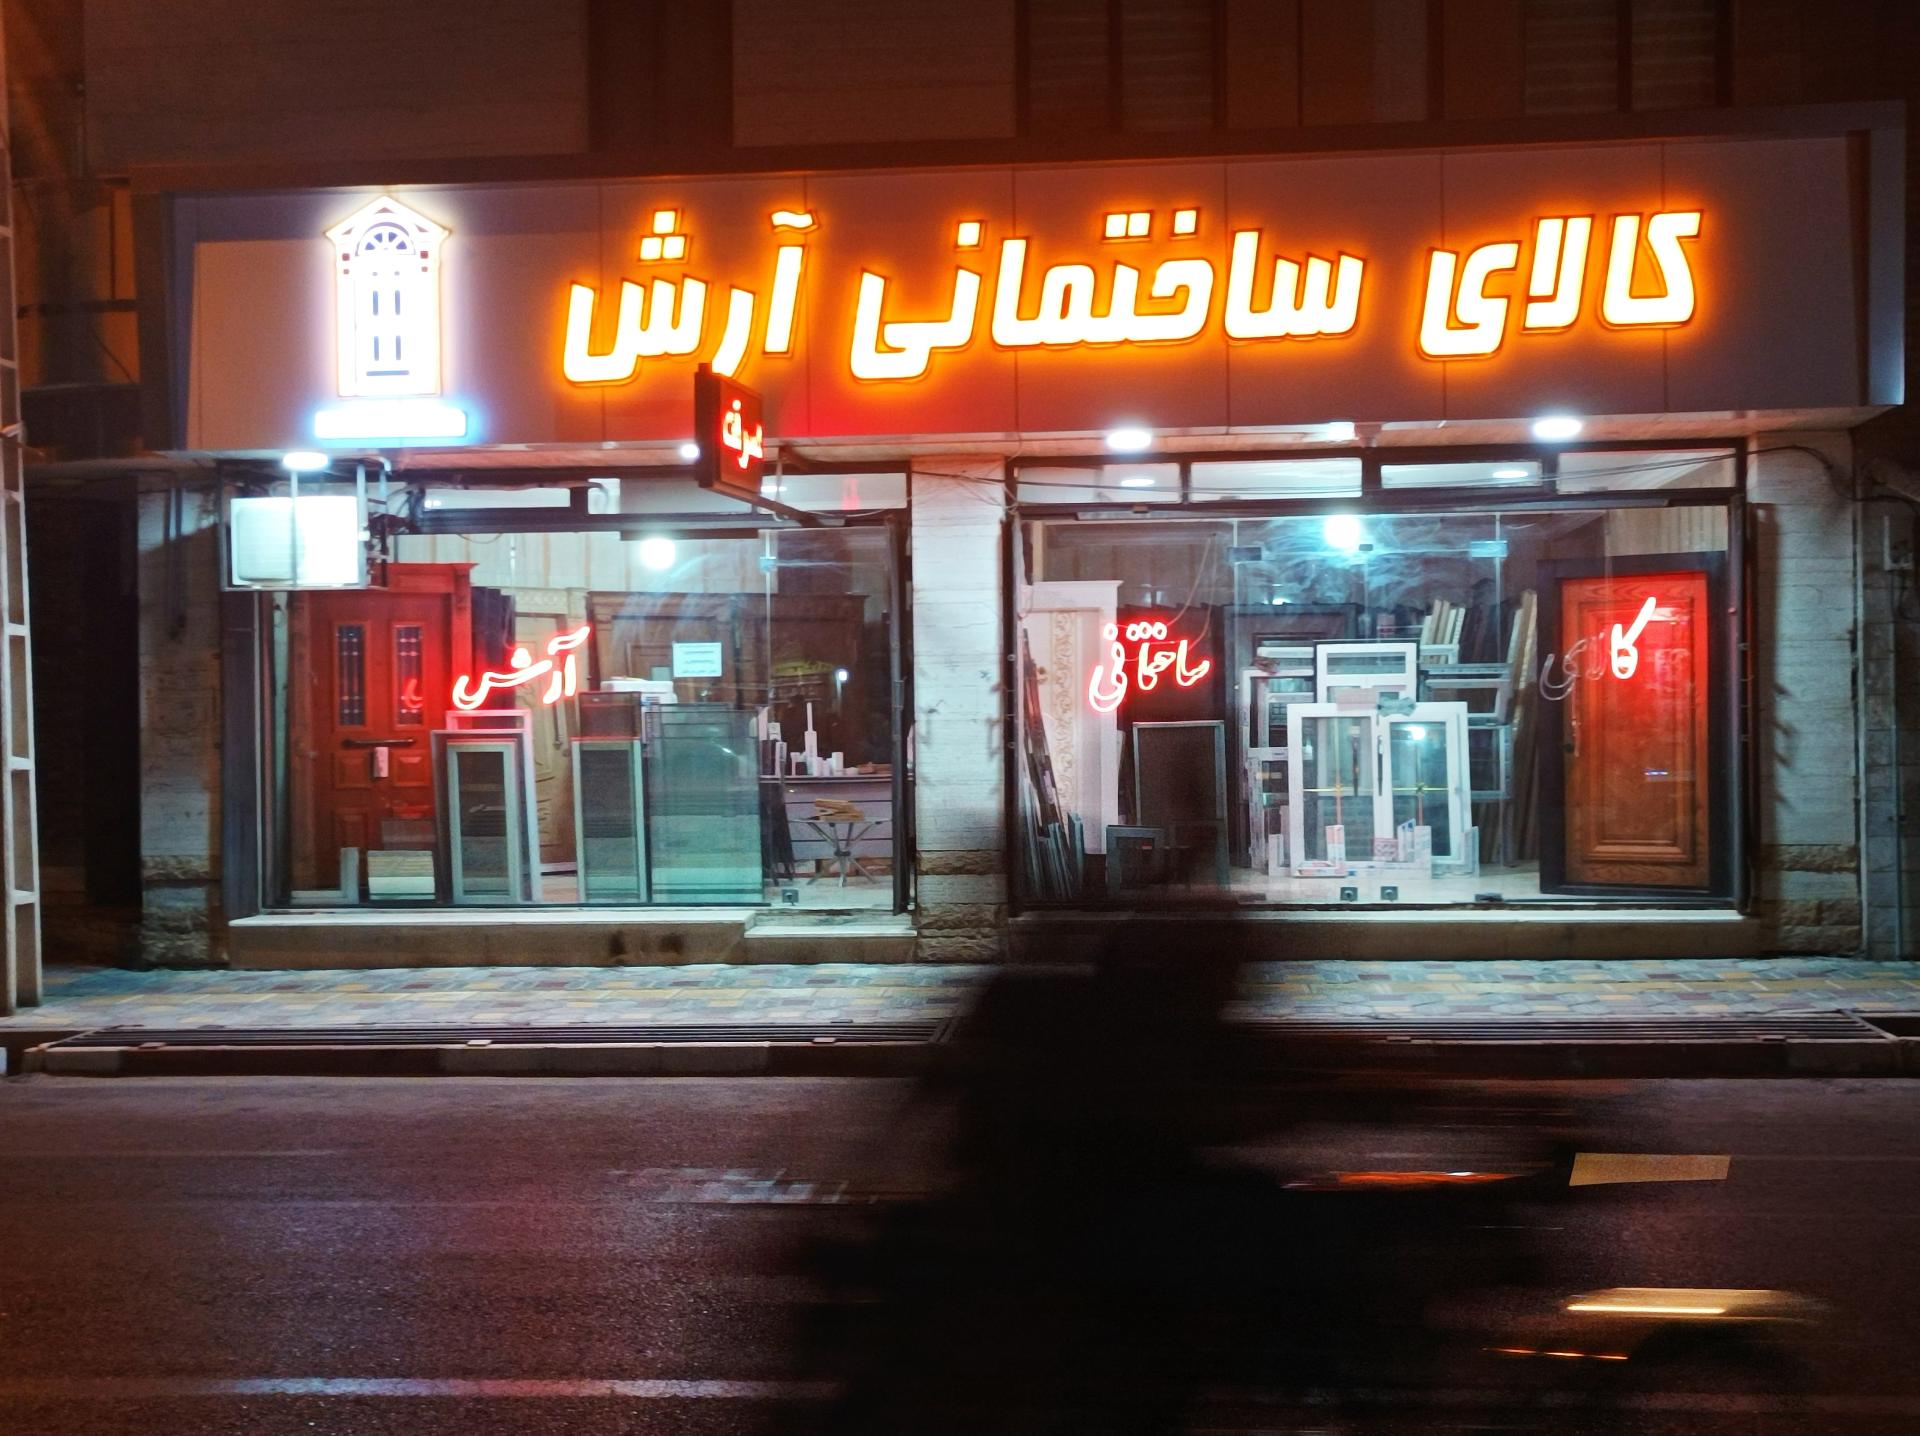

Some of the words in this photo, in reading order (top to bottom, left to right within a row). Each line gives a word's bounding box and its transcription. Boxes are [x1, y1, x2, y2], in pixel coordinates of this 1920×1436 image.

[563, 209, 817, 383] آرش
[849, 208, 1368, 380] ساختمانی
[1419, 209, 1703, 359] کالای
[452, 626, 591, 710] آرش
